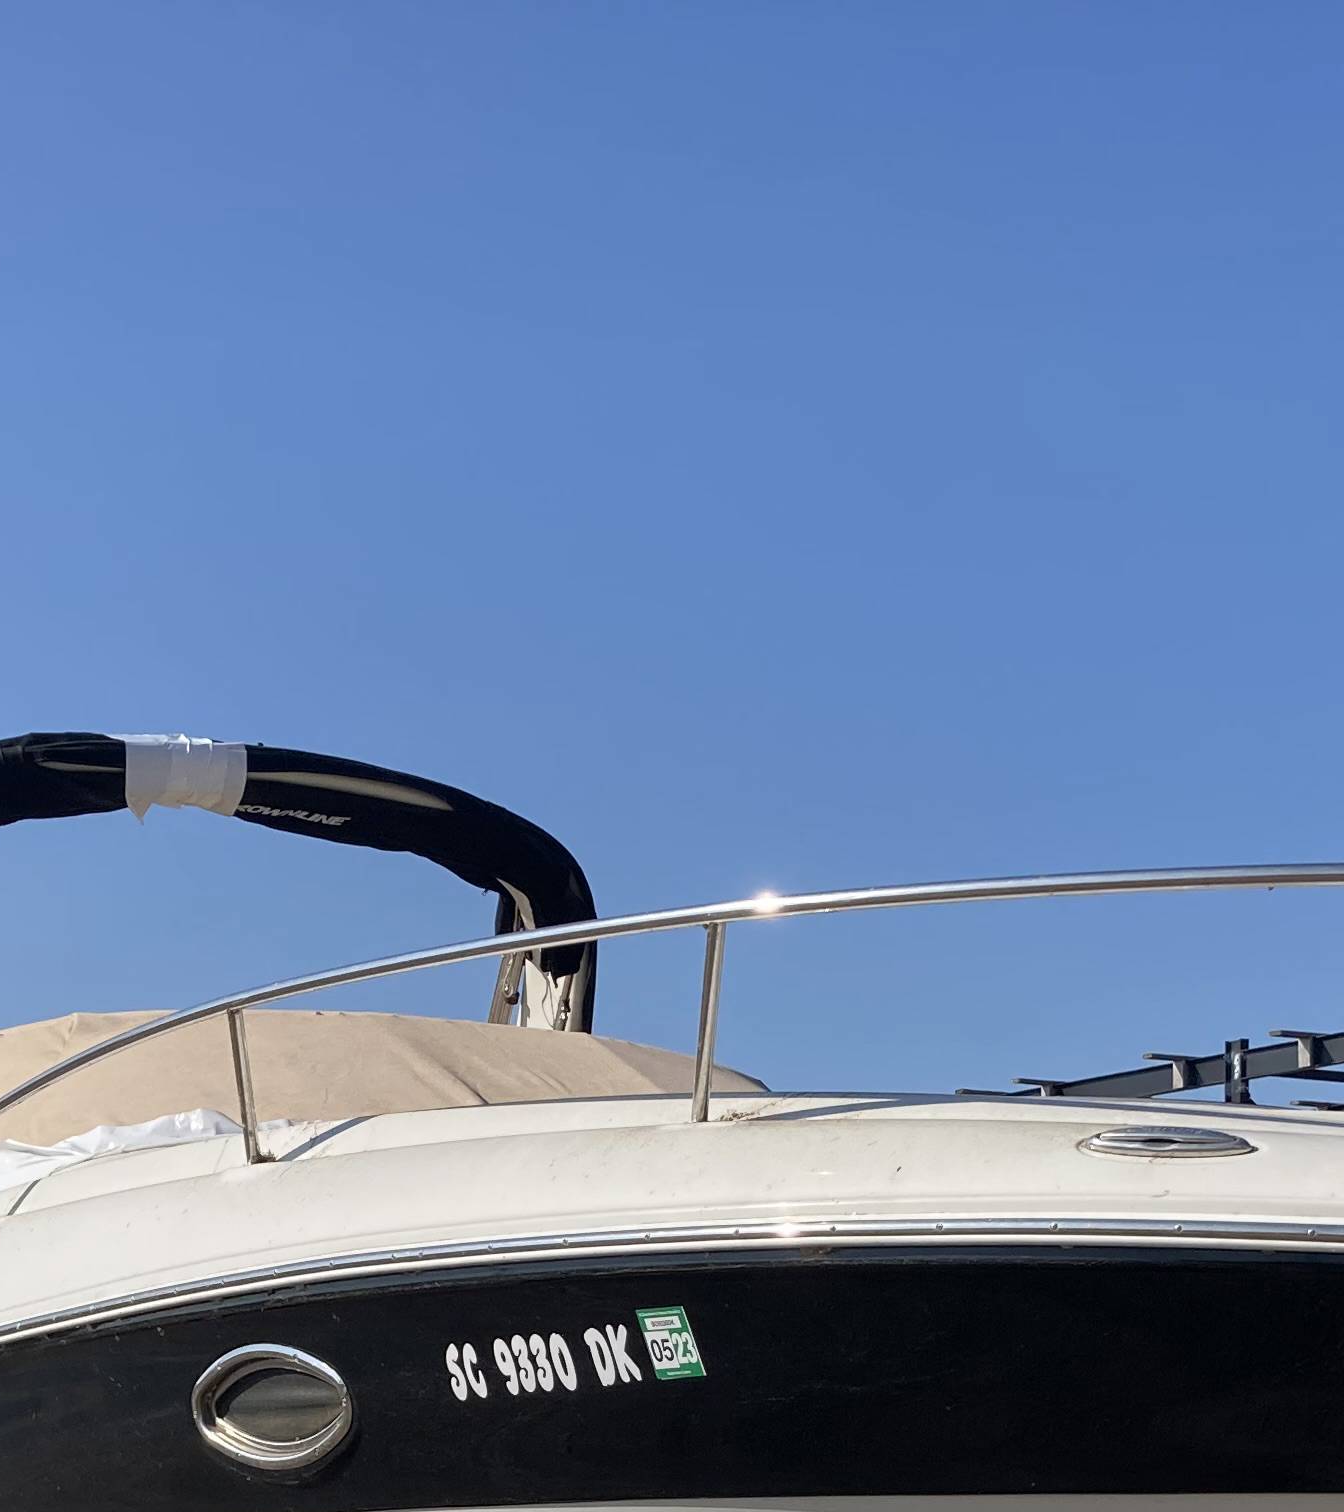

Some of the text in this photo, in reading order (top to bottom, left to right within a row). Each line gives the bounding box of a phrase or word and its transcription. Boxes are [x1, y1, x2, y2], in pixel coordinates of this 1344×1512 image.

[237, 804, 352, 826] ROWNLINE
[445, 1323, 643, 1402] SC 9330 DK
[650, 1331, 698, 1365] 05 23
